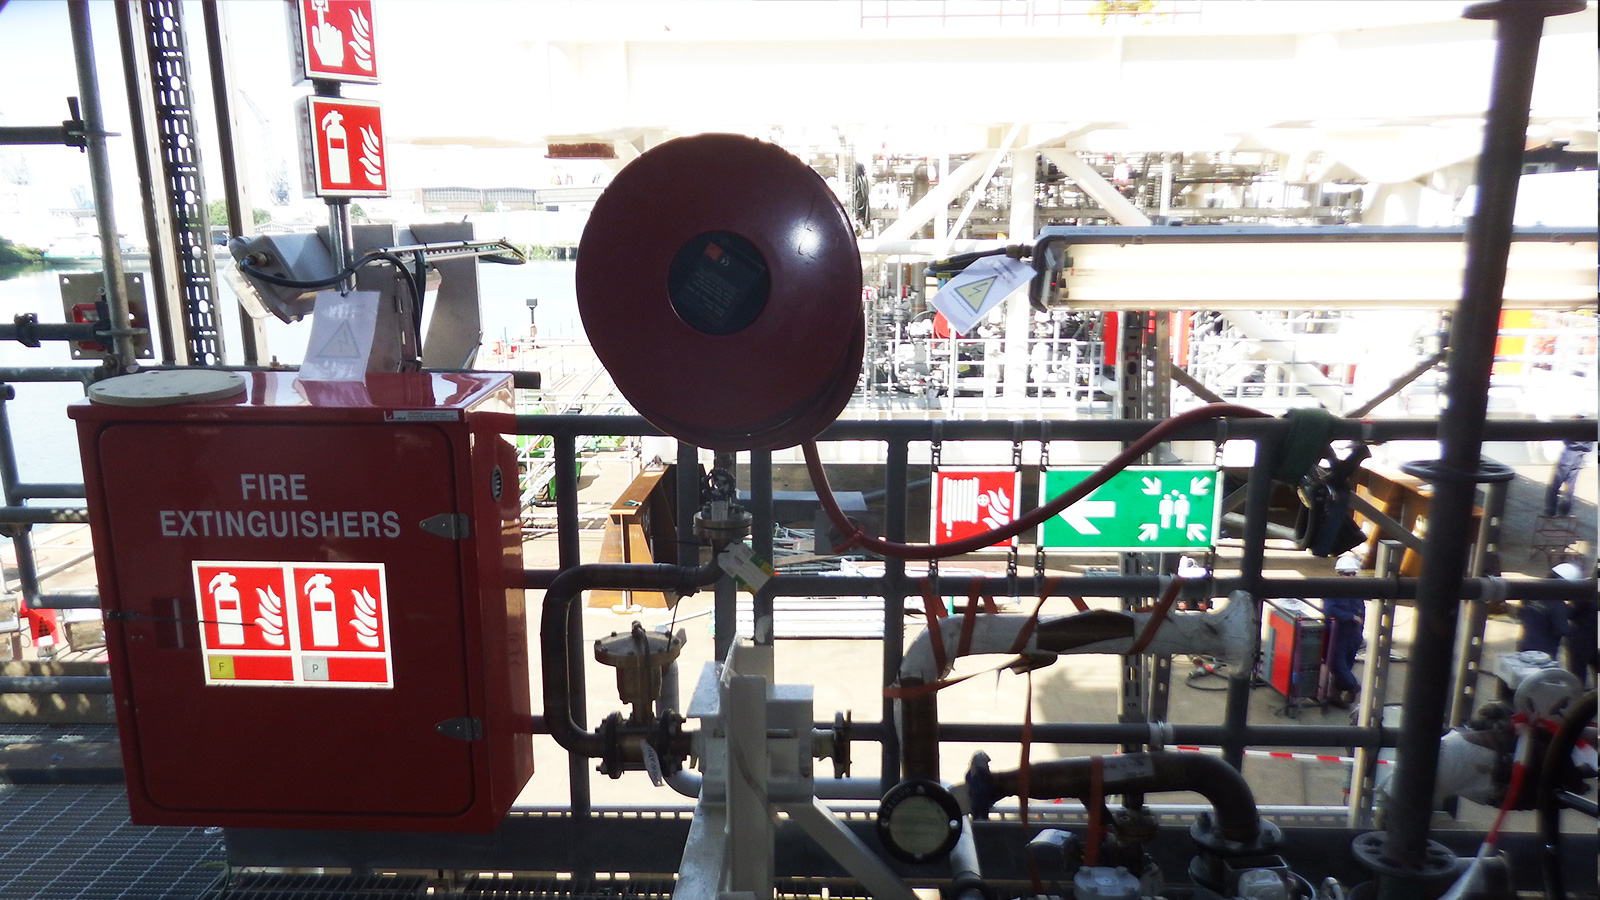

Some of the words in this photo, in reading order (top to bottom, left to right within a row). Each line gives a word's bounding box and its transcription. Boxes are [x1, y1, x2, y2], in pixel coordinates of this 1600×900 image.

[240, 473, 308, 501] FIRE
[159, 510, 401, 538] EXTINGUISHERS
[218, 661, 225, 671] F
[312, 663, 319, 673] P
